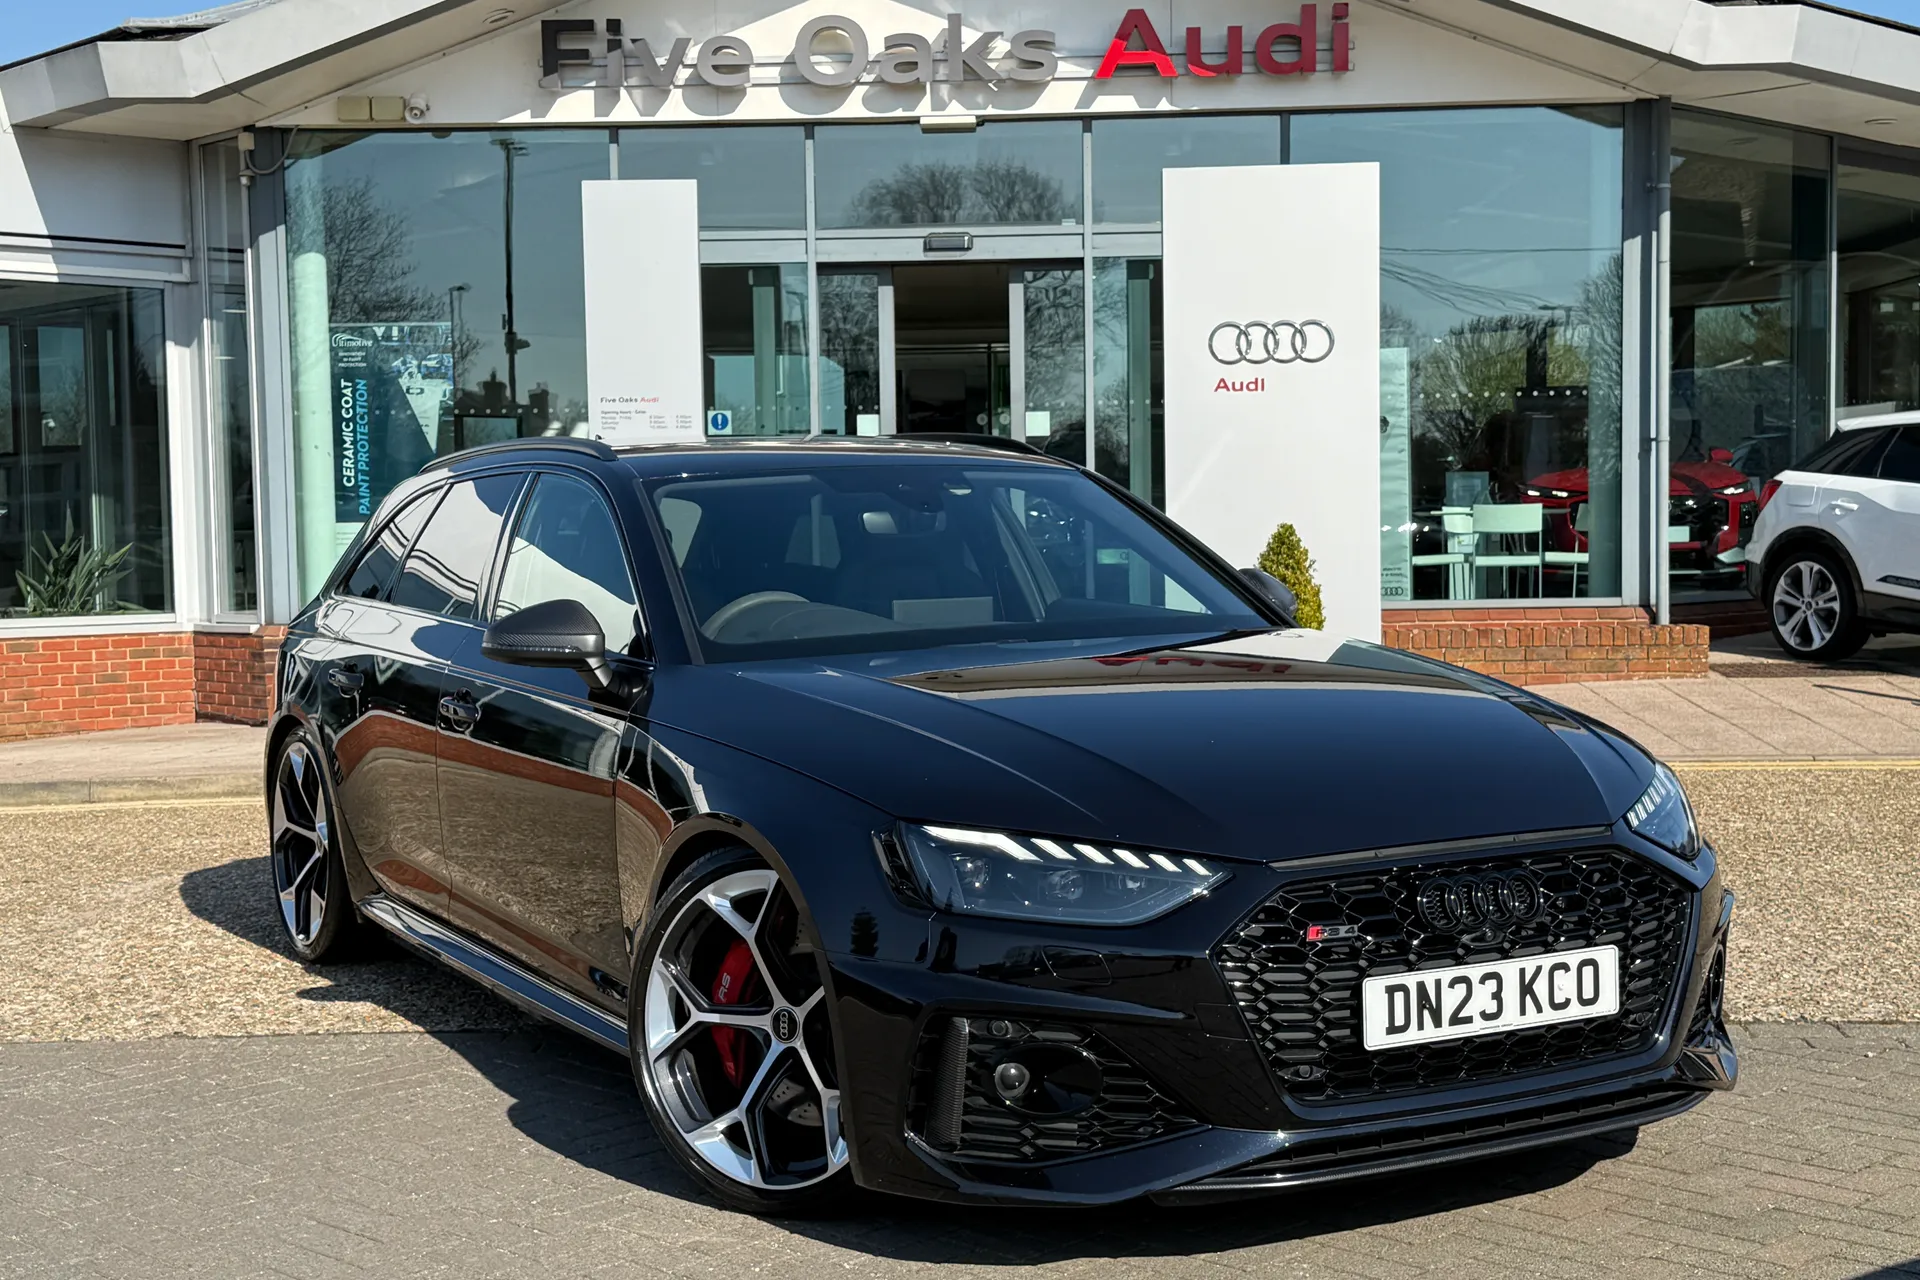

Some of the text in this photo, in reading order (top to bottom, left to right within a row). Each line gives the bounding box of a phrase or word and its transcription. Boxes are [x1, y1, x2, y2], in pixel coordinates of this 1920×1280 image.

[540, 2, 1353, 88] Five Oaks Audi
[1214, 377, 1265, 392] Audi
[340, 378, 356, 487] CERAMIC COAT
[355, 379, 371, 515] PAINT PROTECTION
[718, 972, 731, 1001] RS
[1385, 958, 1600, 1036] DN23 KCO
